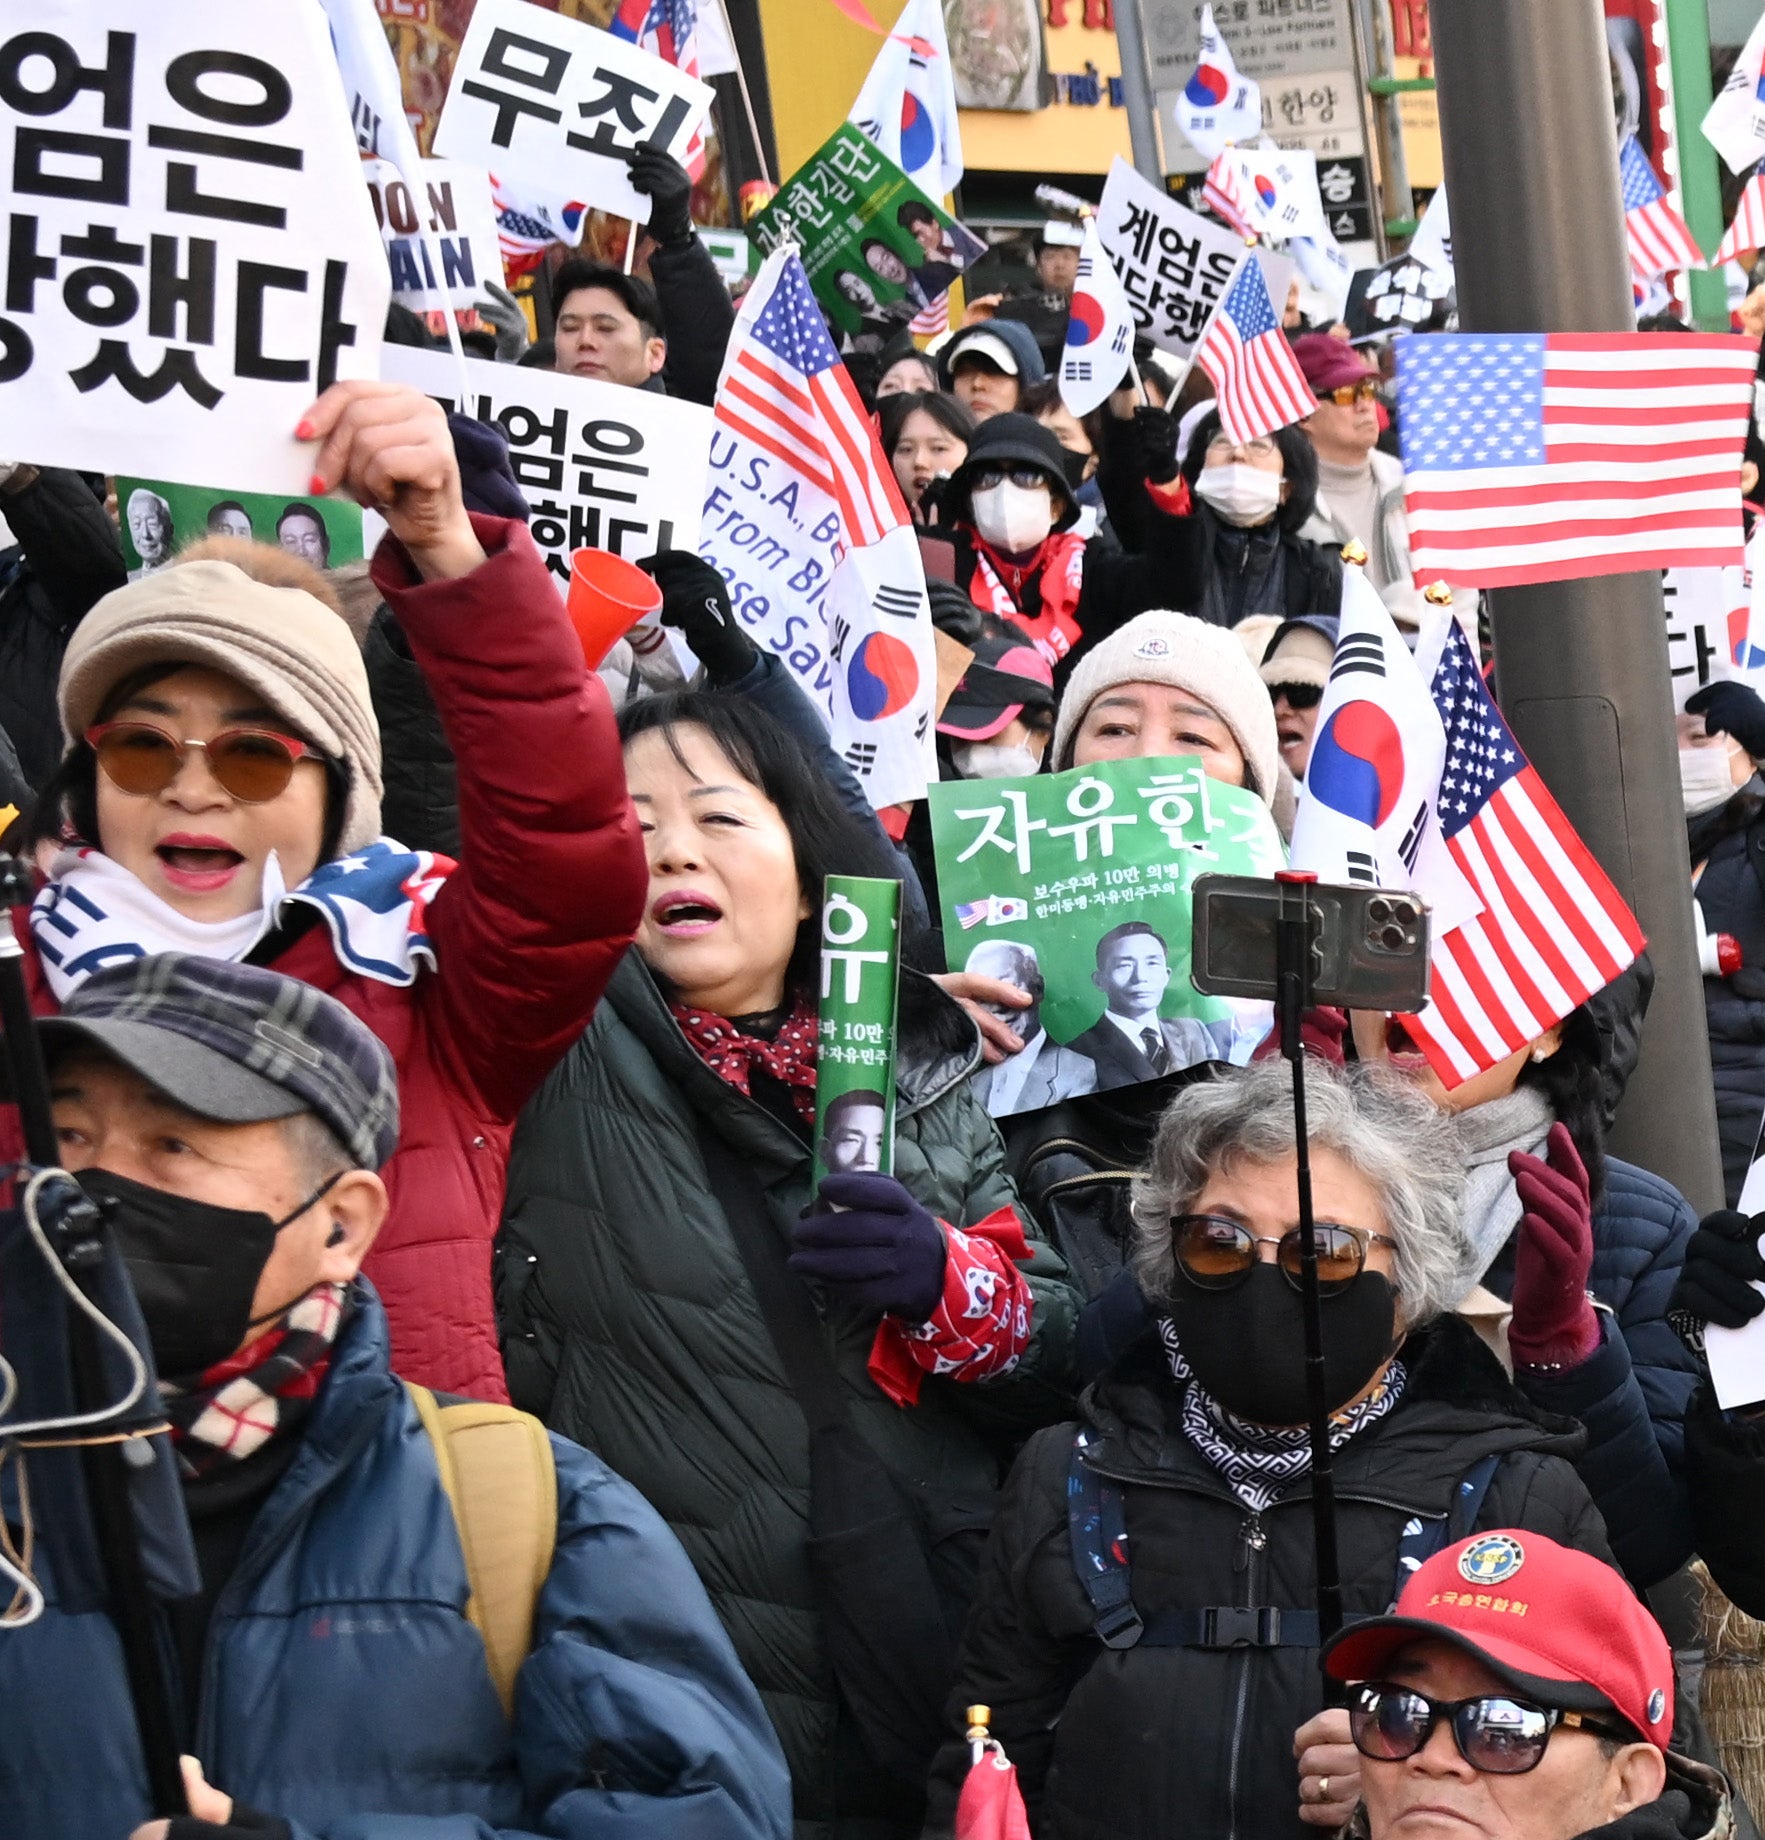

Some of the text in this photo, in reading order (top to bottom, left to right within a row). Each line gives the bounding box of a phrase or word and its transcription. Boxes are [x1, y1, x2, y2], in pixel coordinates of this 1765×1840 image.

[461, 27, 692, 161] 무죄
[1104, 866, 1141, 886] 10만
[844, 1022, 885, 1044] 10만
